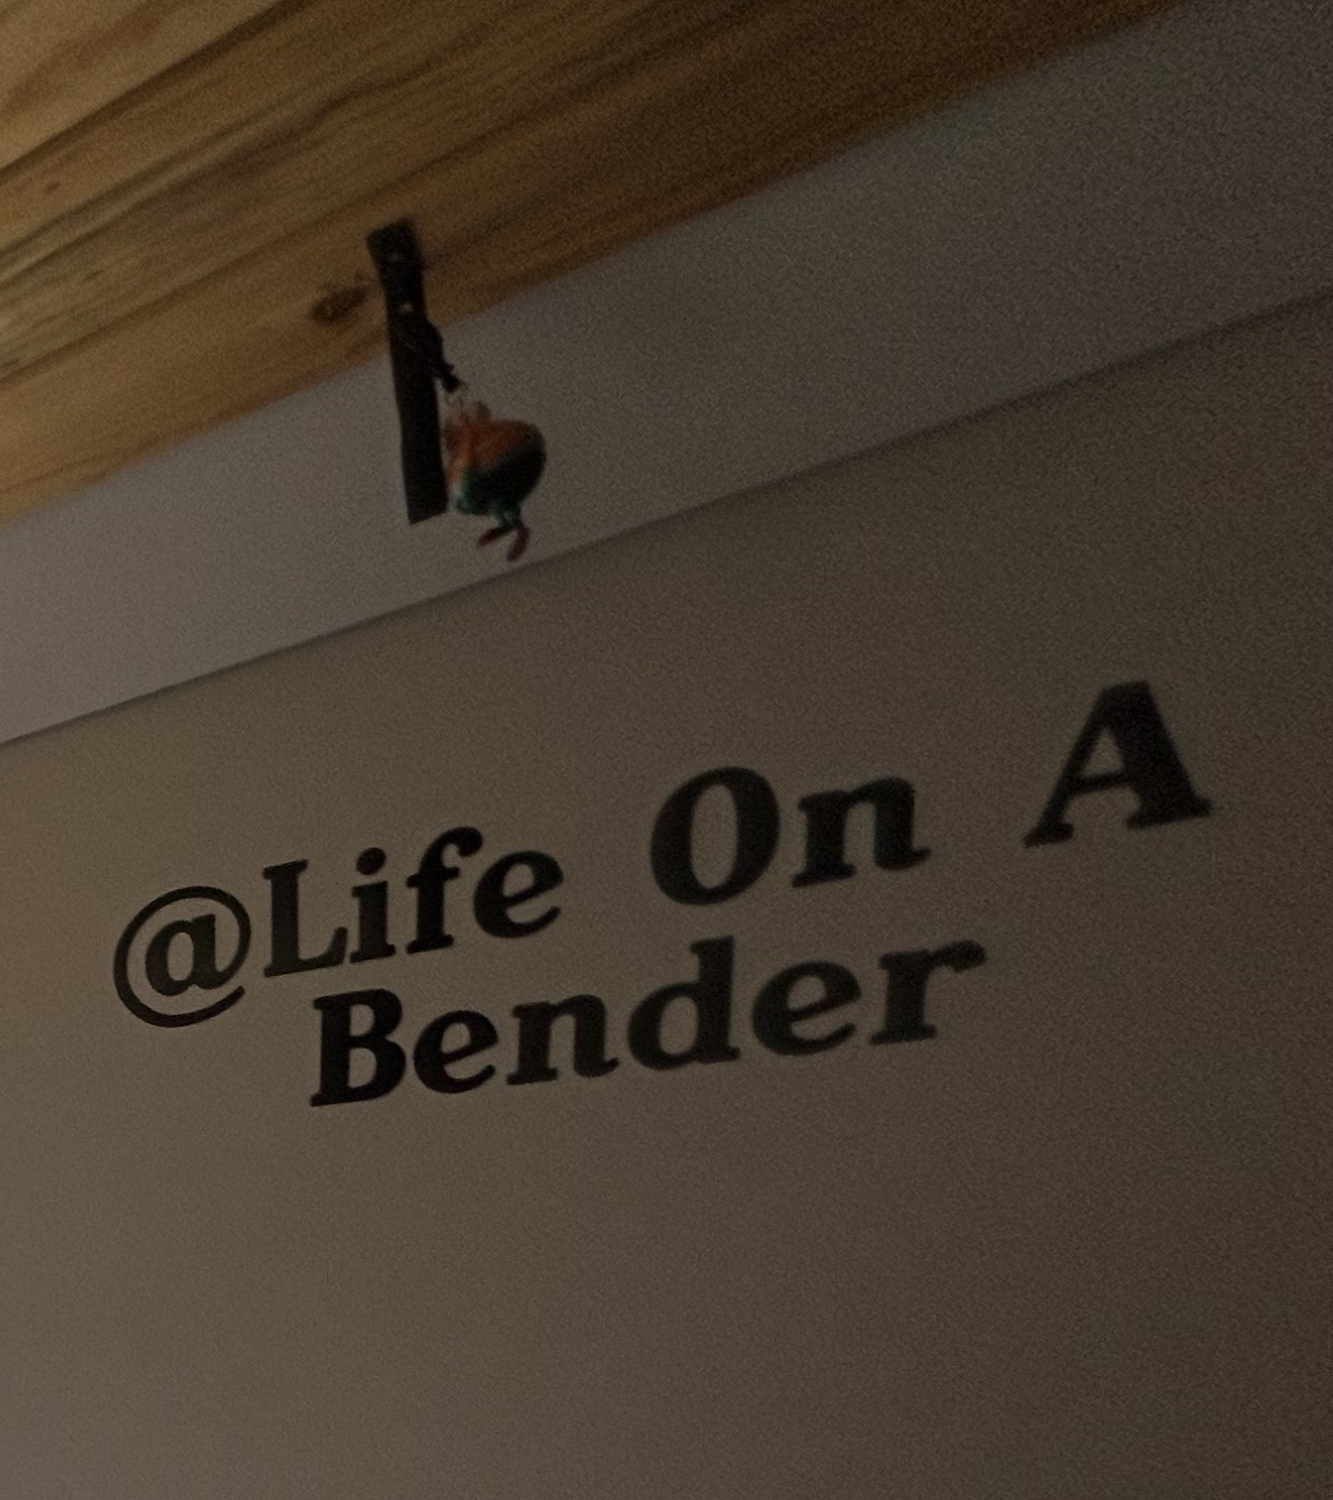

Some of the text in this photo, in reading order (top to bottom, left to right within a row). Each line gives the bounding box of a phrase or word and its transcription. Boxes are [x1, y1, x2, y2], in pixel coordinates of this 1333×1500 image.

[112, 680, 1215, 1029] @Life On A
[309, 936, 988, 1108] Bender
